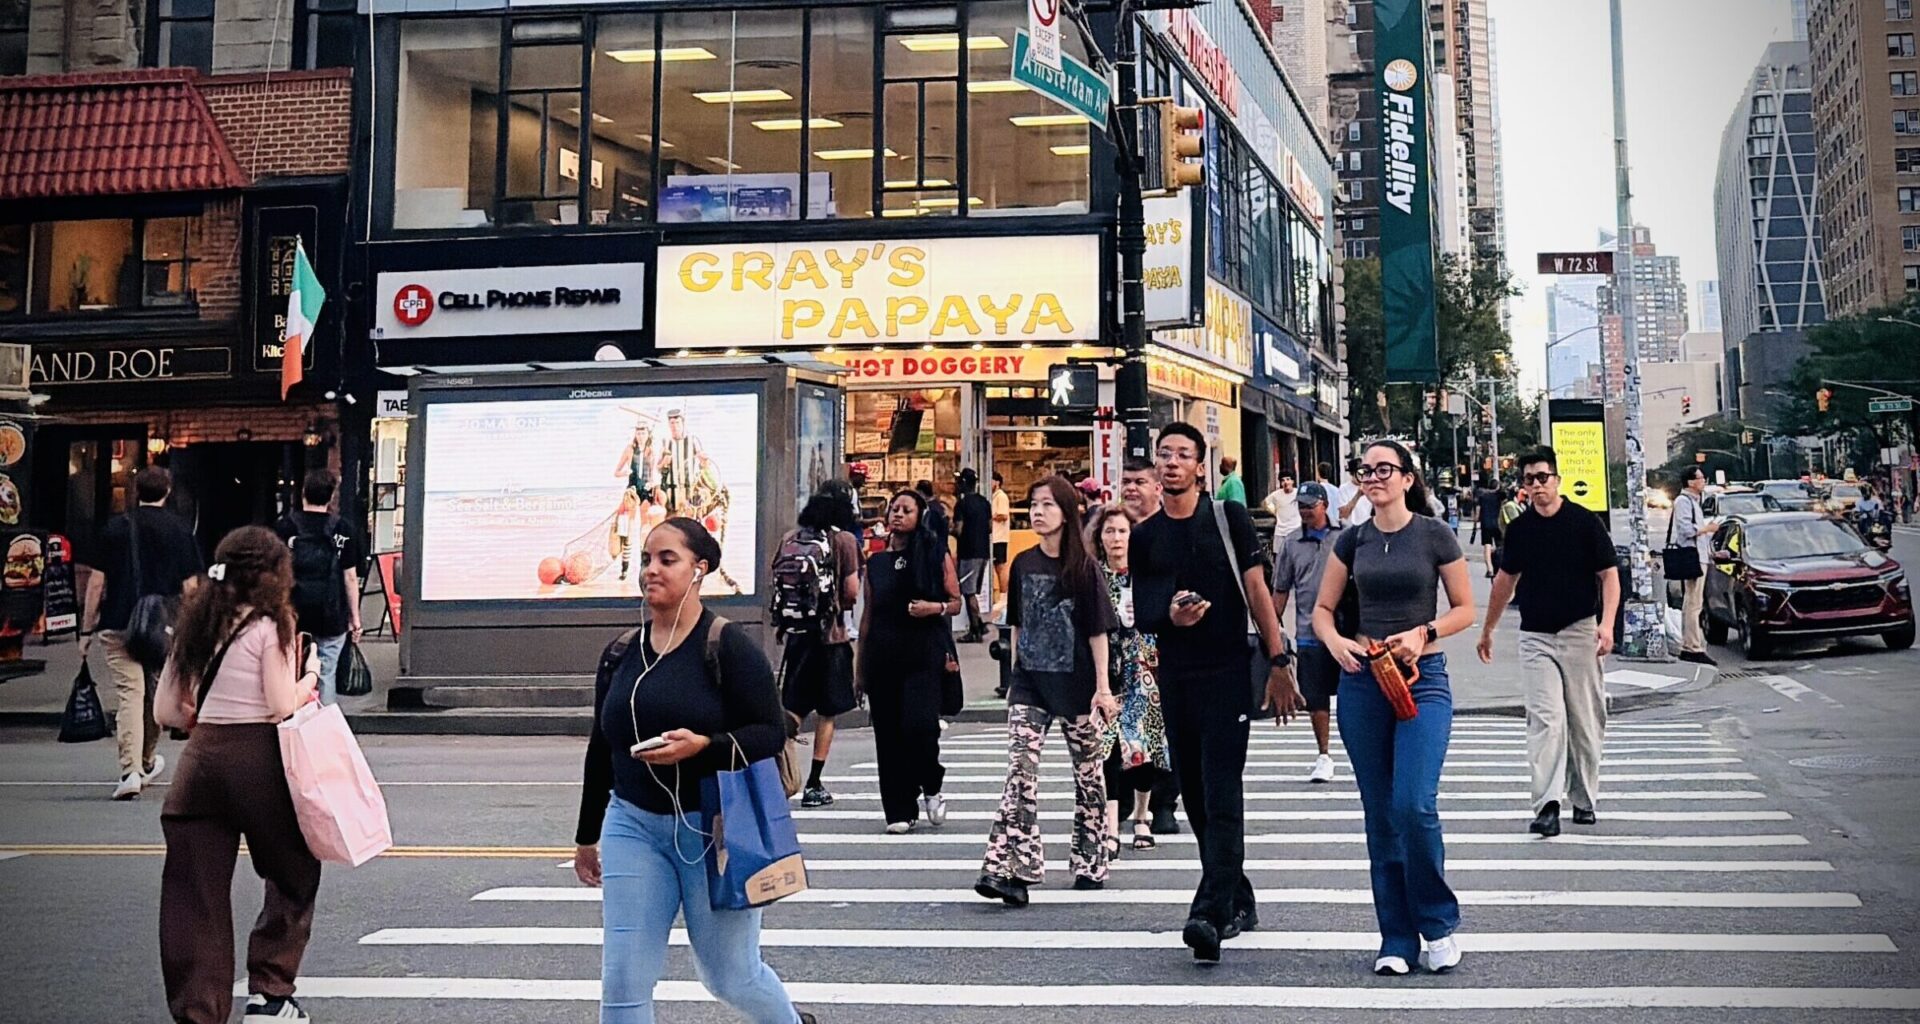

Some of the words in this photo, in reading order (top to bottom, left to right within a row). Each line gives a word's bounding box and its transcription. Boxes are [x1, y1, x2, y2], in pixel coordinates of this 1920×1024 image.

[1021, 47, 1094, 108] Amsterdam
[1387, 92, 1417, 215] Fidelity
[1145, 219, 1183, 245] AY'S
[678, 242, 927, 292] GRAY'S
[1554, 258, 1564, 273] W
[1567, 257, 1582, 272] 72
[1586, 256, 1599, 272] St
[1144, 266, 1183, 290] PAYA
[402, 299, 424, 310] CPR
[438, 291, 485, 310] CELL
[487, 289, 552, 308] PHONE
[555, 286, 621, 306] REPAIR
[780, 293, 1075, 340] PAPAYA
[30, 352, 96, 382] AND
[107, 348, 174, 380] ROE
[845, 358, 894, 377] HOT
[902, 355, 1026, 376] DOGGERY
[568, 389, 613, 399] JCDecaux
[1561, 439, 1585, 447] thing
[1577, 429, 1597, 438] only
[1565, 457, 1592, 465] that's
[1579, 448, 1599, 456] York
